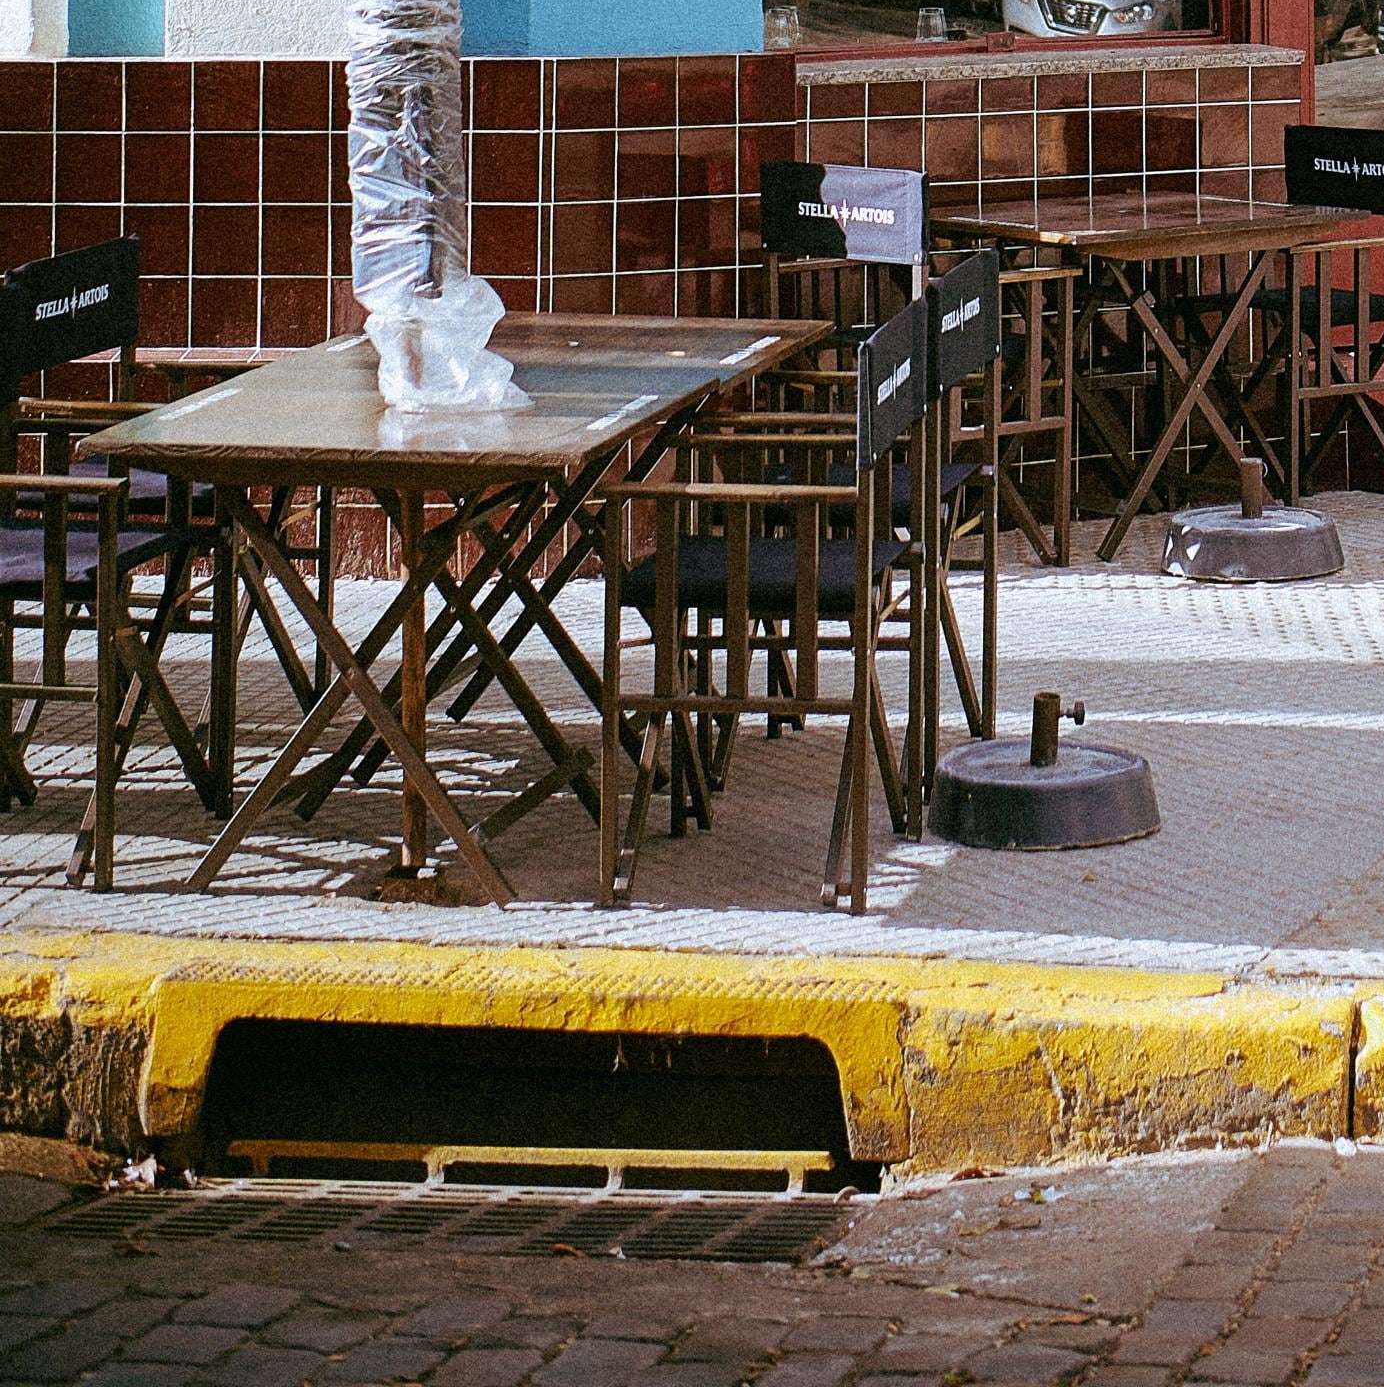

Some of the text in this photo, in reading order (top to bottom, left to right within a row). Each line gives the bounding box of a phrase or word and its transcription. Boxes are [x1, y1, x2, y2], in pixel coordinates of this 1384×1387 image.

[1314, 157, 1351, 174] STELLA
[798, 201, 895, 225] STELLA ARTOIS
[35, 283, 109, 321] STELLA ARTOIS
